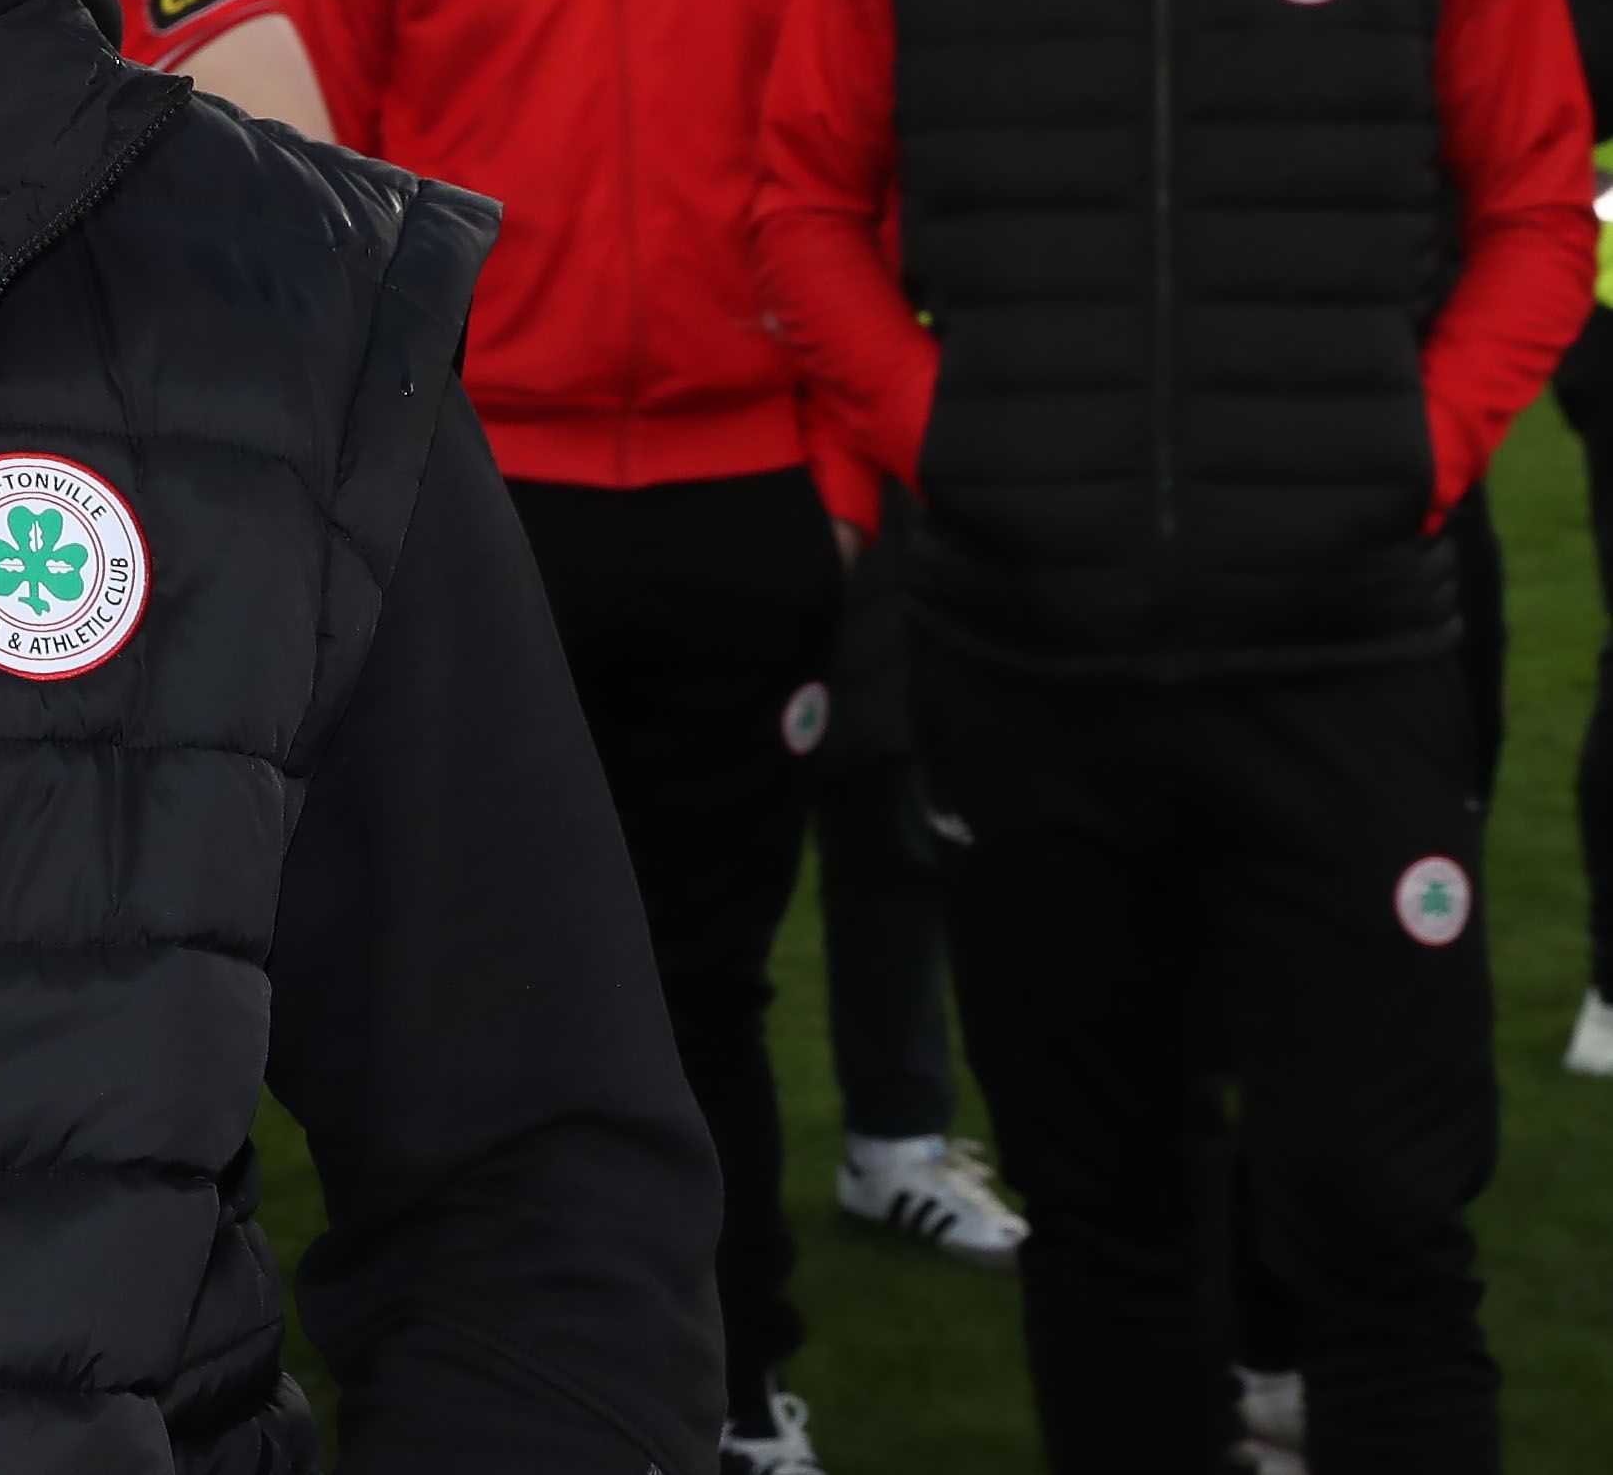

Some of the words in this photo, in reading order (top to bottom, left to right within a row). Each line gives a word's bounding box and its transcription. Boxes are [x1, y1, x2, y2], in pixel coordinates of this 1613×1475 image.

[8, 632, 22, 652] &
[28, 606, 114, 655] ATHLETIC
[104, 557, 129, 606] CLUB
